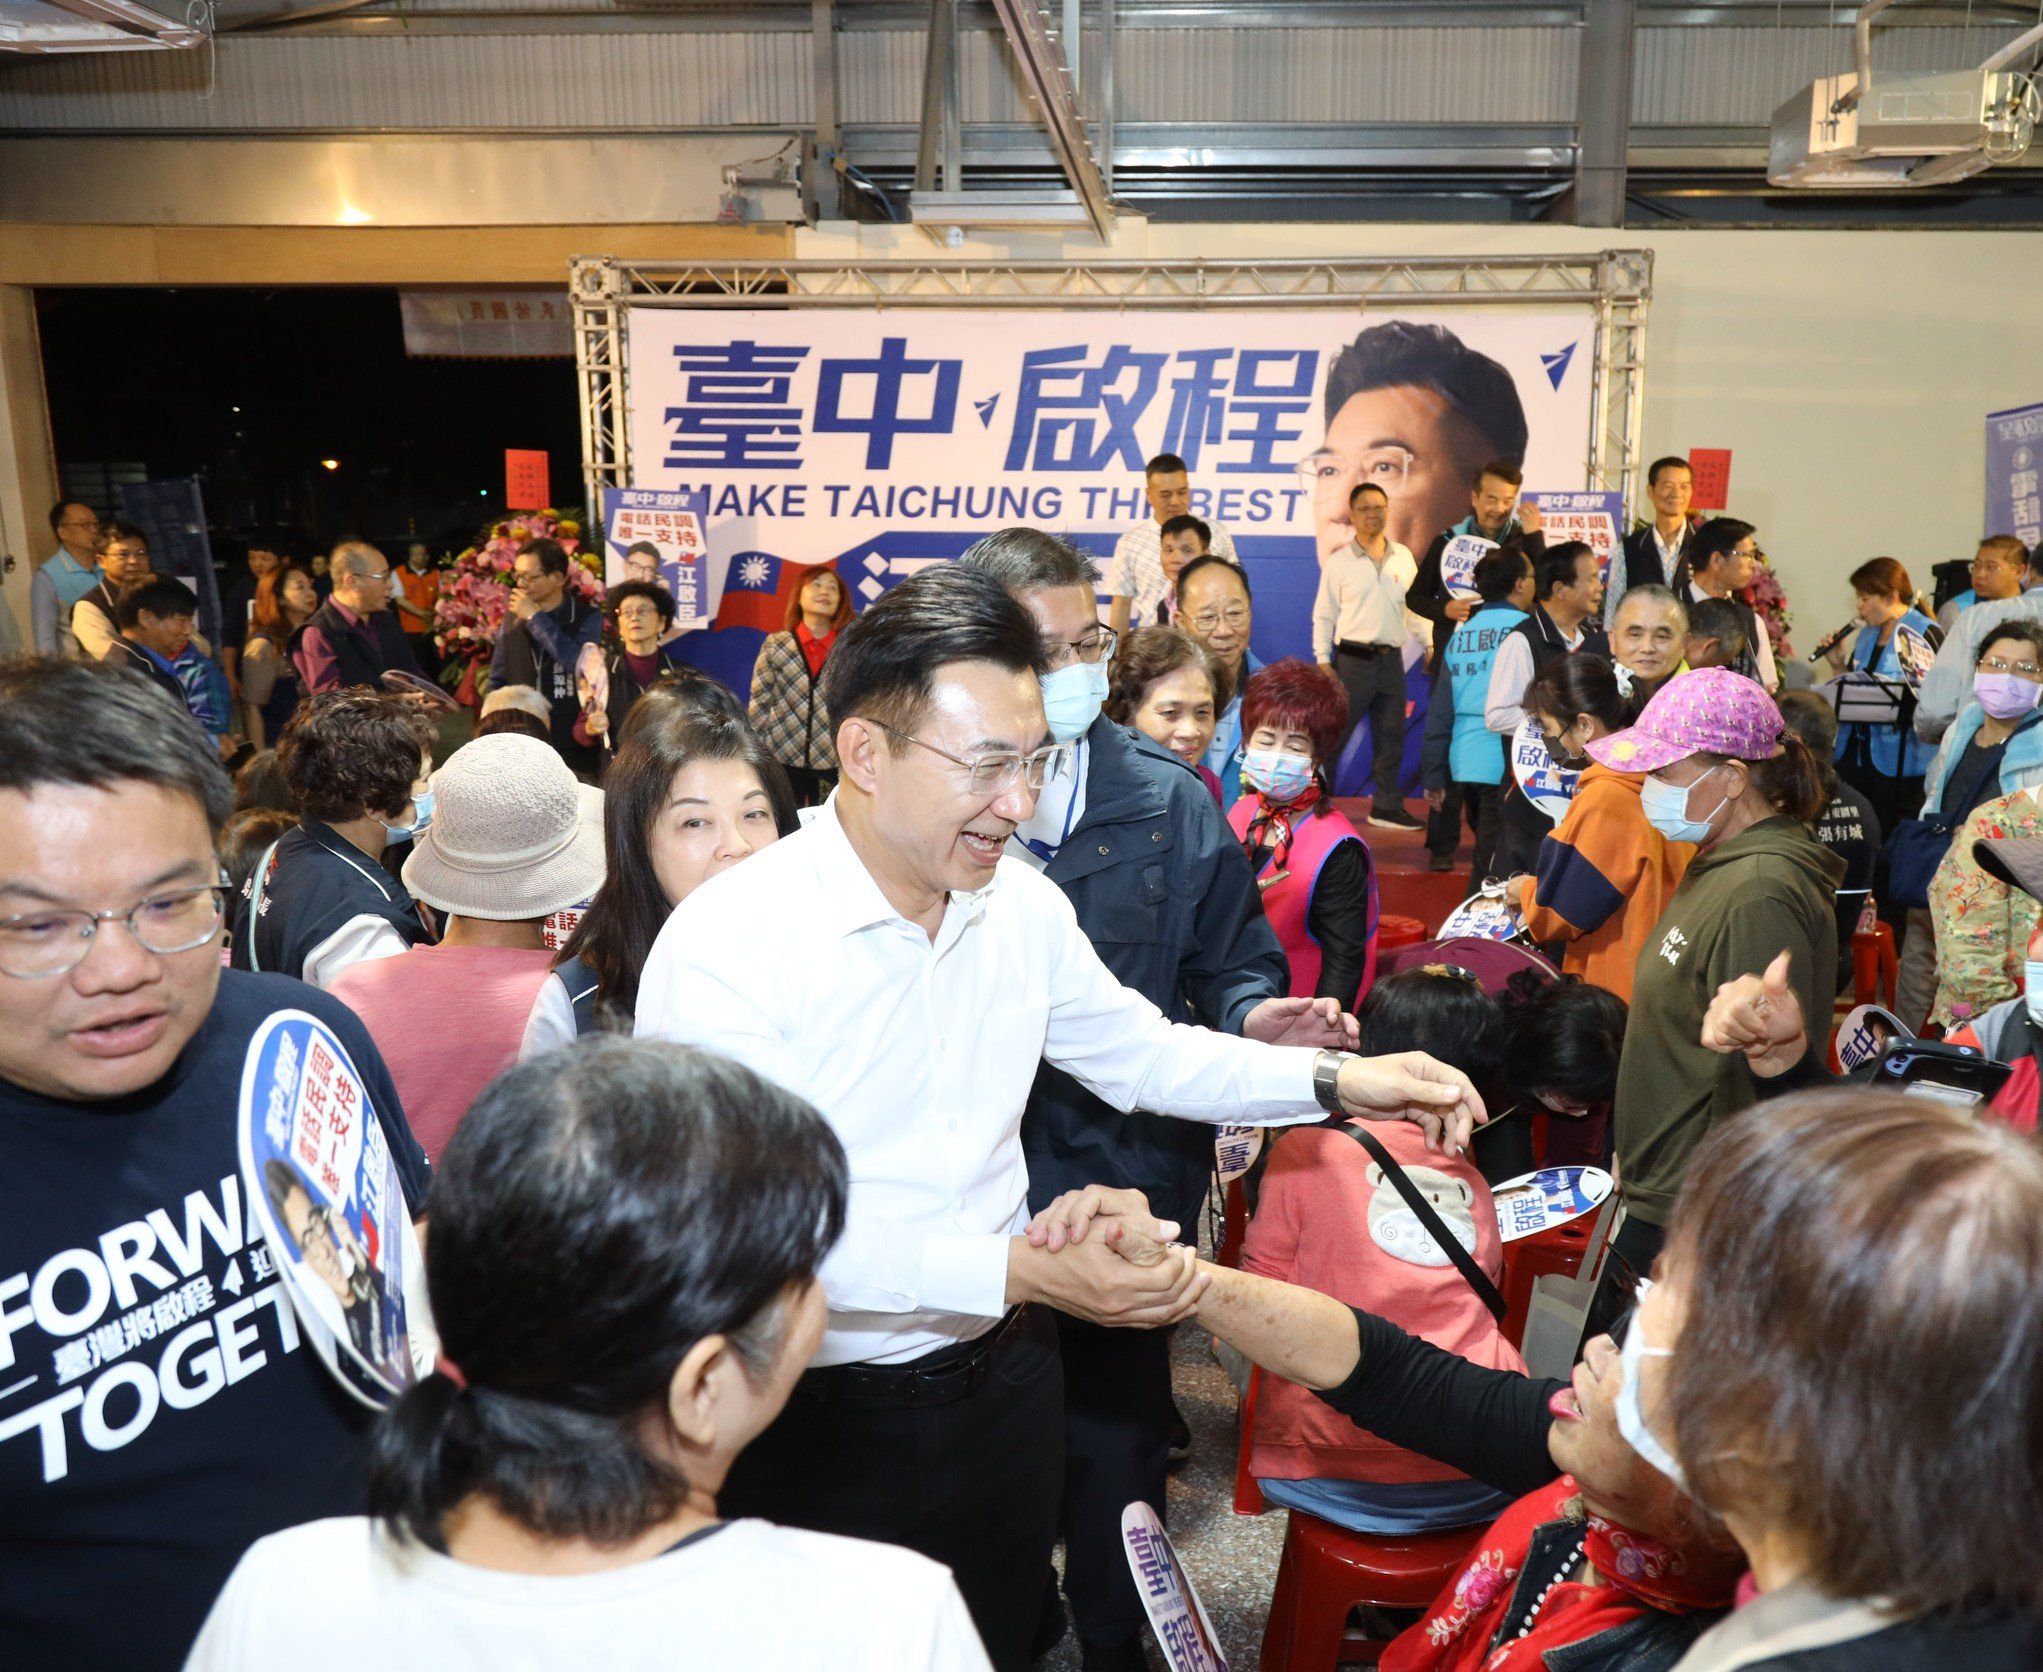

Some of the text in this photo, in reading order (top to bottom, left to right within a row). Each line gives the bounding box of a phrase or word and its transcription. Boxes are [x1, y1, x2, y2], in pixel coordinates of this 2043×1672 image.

[663, 337, 1320, 475] 臺中 啟程
[618, 526, 698, 548] 唯一支持
[619, 511, 695, 529] 電話民調
[823, 484, 1061, 519] TAICHUNG
[1079, 486, 1152, 520] TH
[1191, 488, 1308, 522] BEST
[1544, 530, 1612, 549] 一支持
[299, 1042, 334, 1167] 電話民調
[321, 1074, 356, 1196] 唯一支持
[0, 1175, 263, 1372] FORW
